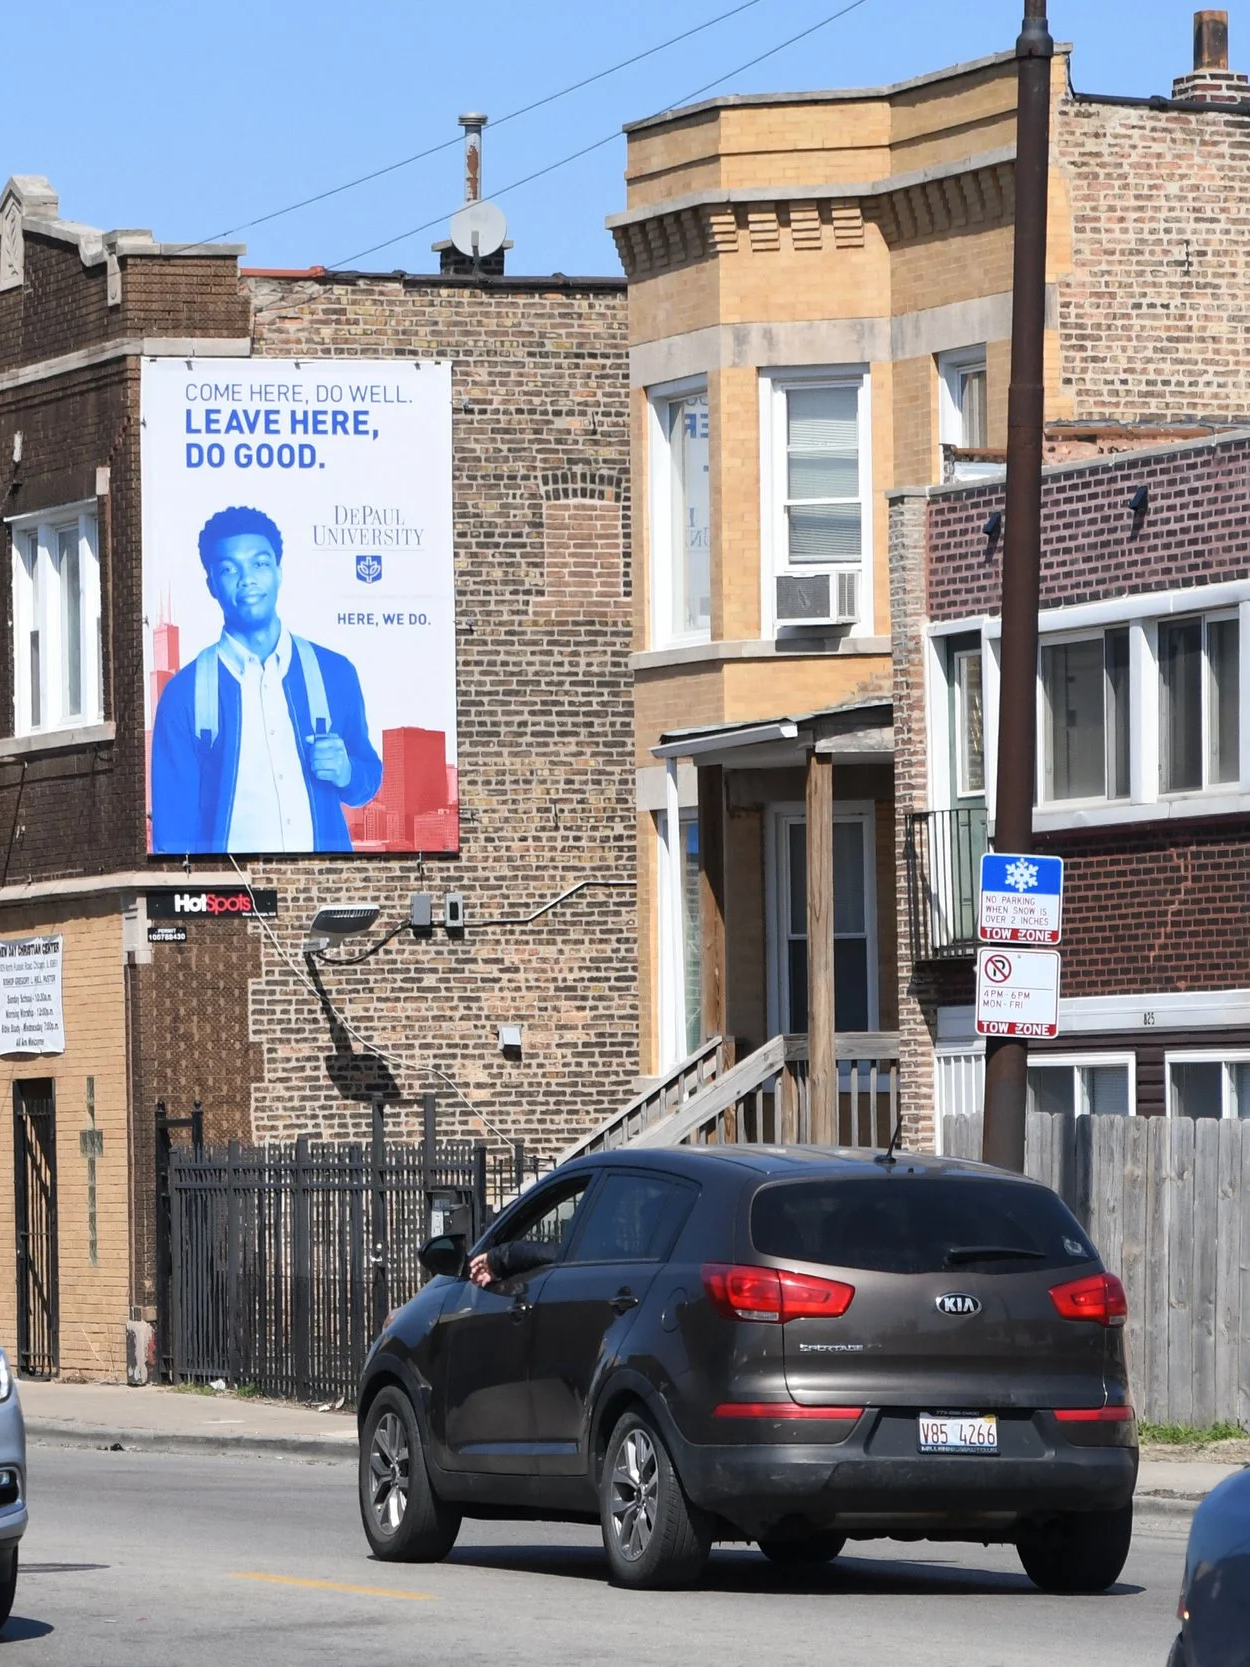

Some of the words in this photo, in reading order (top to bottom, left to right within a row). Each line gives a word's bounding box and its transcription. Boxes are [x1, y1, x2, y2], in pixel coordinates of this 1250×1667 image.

[185, 383, 243, 402] COME
[251, 384, 309, 405] HERE,
[316, 385, 343, 403] DO
[348, 385, 413, 404] WELL.
[185, 409, 281, 435] LEAVE
[290, 410, 379, 441] HERE,
[186, 443, 225, 469] DO
[234, 443, 325, 469] GOOD.
[313, 525, 425, 546] UNIVERSITY
[337, 613, 379, 627] HERE,
[382, 613, 404, 625] WE
[409, 613, 431, 625] DO.
[174, 893, 251, 915] HotSpots
[985, 895, 997, 903] NO
[1002, 896, 1036, 905] PARKING
[985, 905, 1008, 914] WHEN
[1013, 906, 1036, 915] SNOW
[1040, 908, 1048, 916] IS
[985, 915, 1006, 924] OVER
[1011, 916, 1016, 924] 2
[1020, 917, 1049, 926] INCHES
[985, 928, 1012, 940] TOW
[1017, 930, 1053, 942] ZONE
[8, 945, 16, 957] DAY
[18, 943, 41, 956] CHRISTIAN
[42, 942, 59, 955] CENTER
[984, 989, 1003, 998] 4PM
[1011, 991, 1030, 1000] 6PM
[982, 1000, 1002, 1008] MON
[1009, 1001, 1023, 1009] FRI
[981, 1021, 1009, 1033] TOW
[1015, 1023, 1050, 1036] ZONE
[943, 1298, 975, 1312] KIA
[922, 1423, 948, 1444] V85
[959, 1424, 996, 1445] 4266
